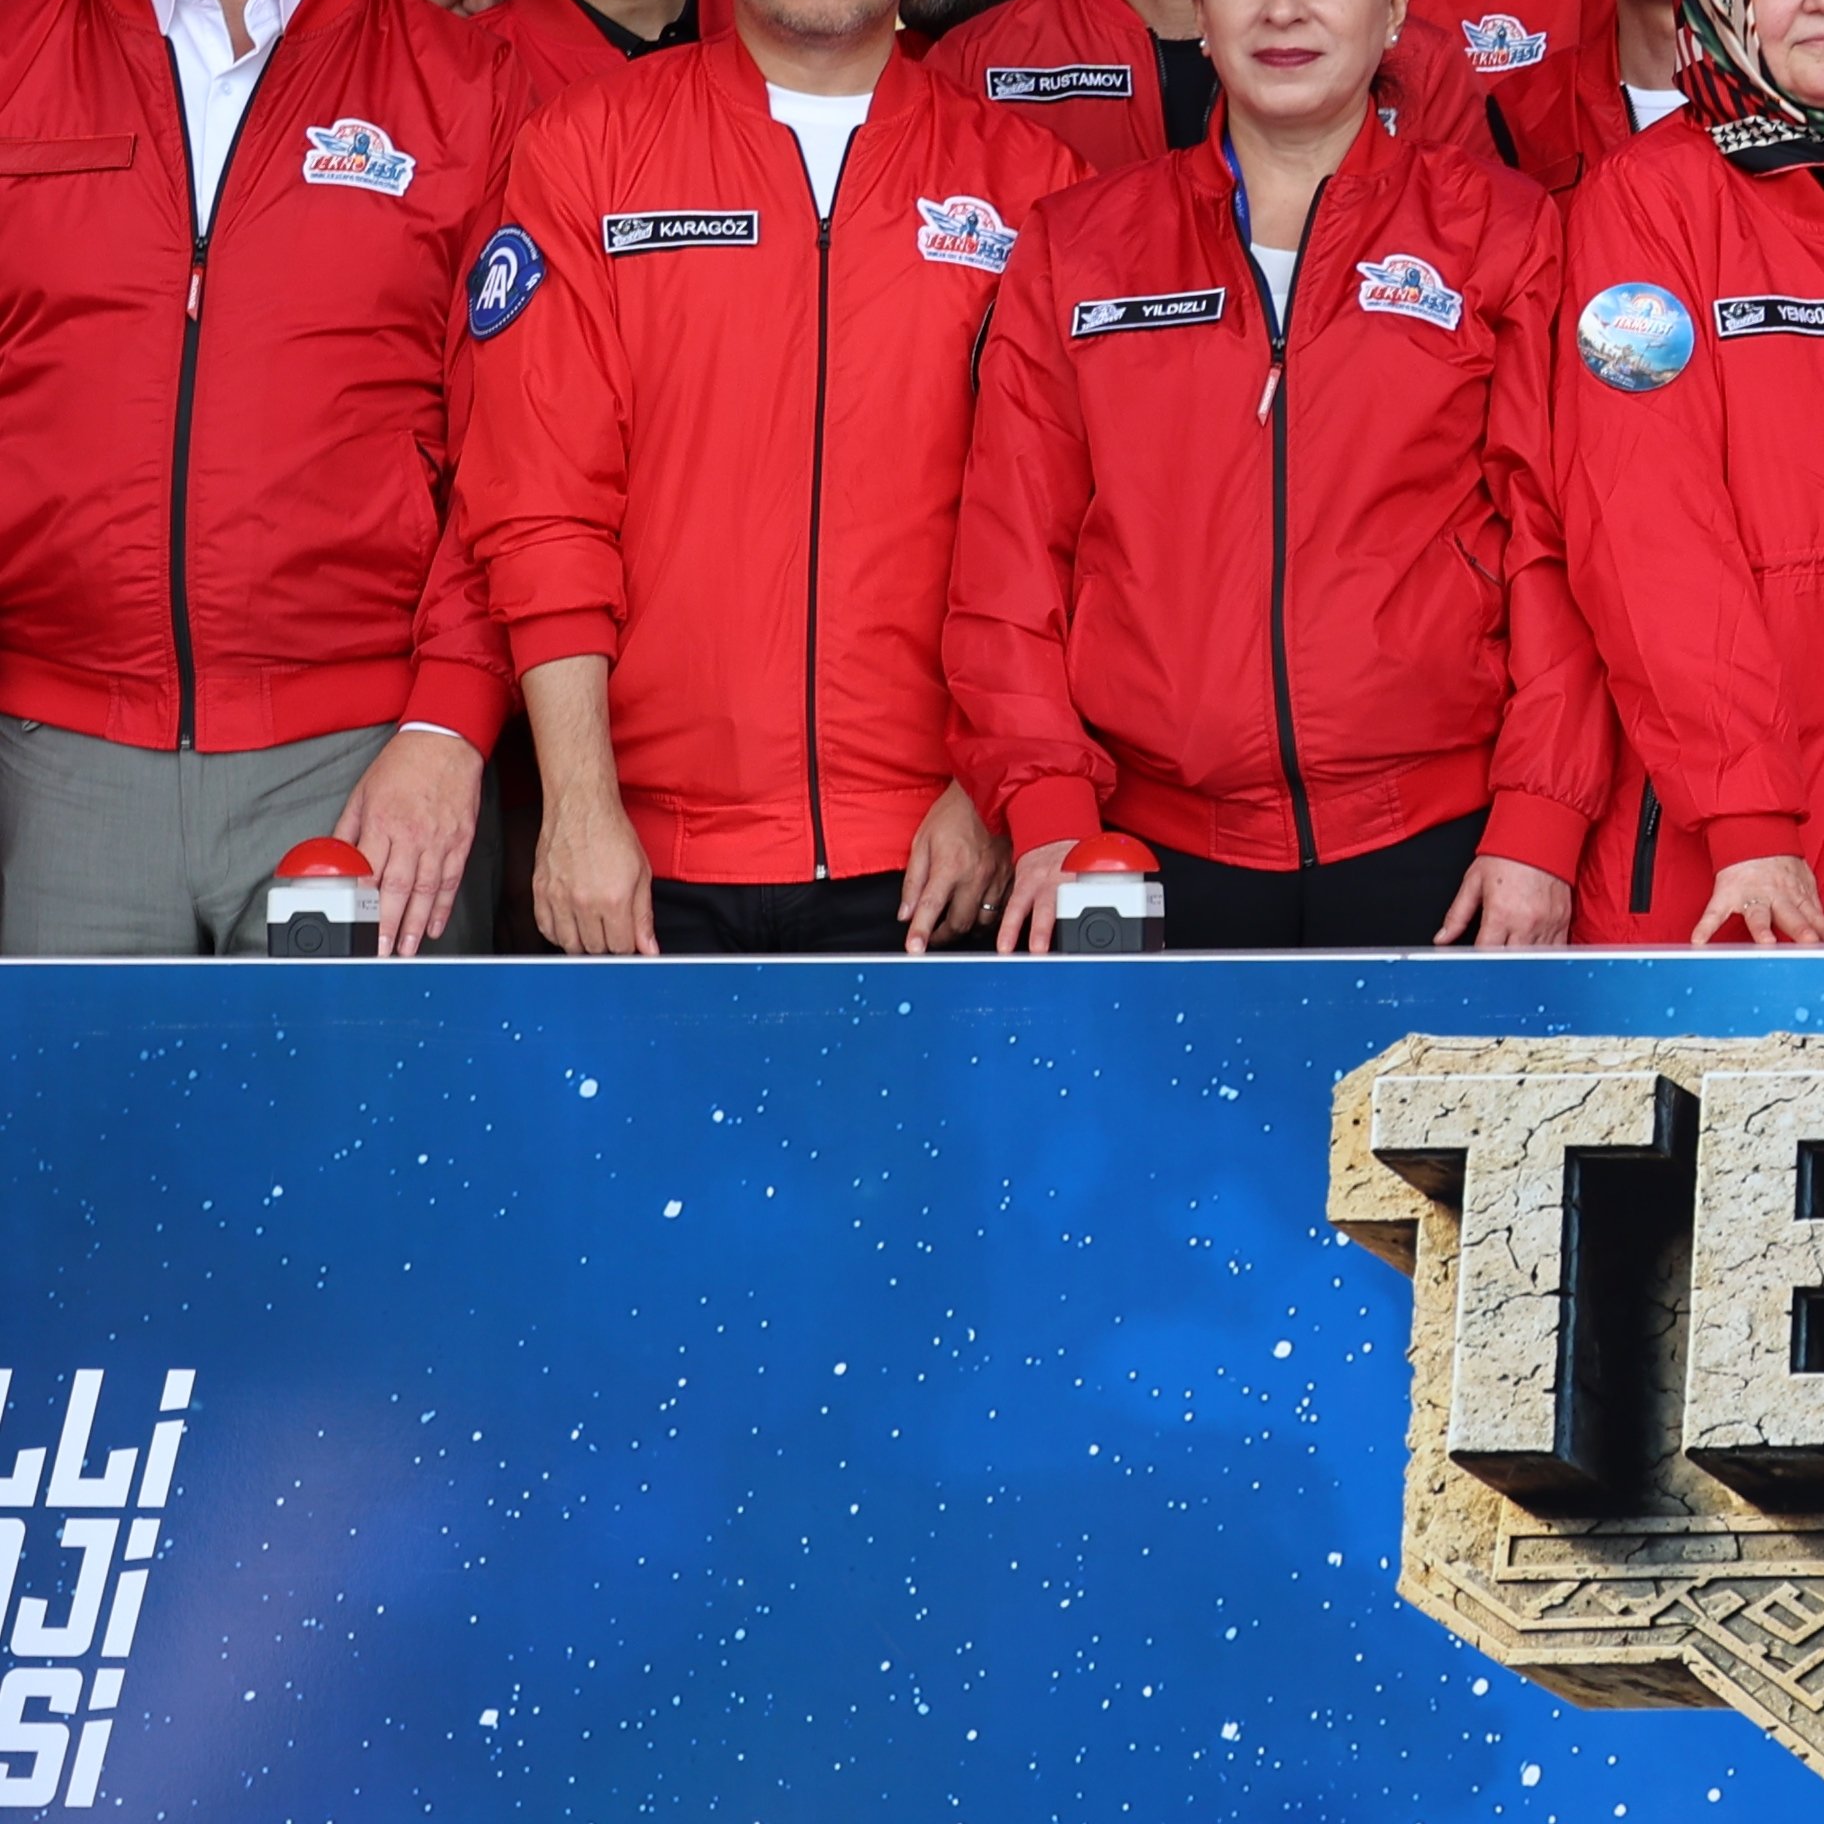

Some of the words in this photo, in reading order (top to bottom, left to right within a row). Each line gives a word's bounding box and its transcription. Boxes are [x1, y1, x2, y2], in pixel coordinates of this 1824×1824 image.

[1039, 72, 1124, 91] RUSTAMOV
[309, 154, 407, 182] TEKNOFEST
[659, 218, 748, 238] KARAGÖZ
[924, 231, 1013, 263] TEKNOFEST
[475, 263, 508, 311] AA
[1365, 284, 1454, 317] TEKNOFEST
[1142, 299, 1208, 319] YILDIZLI
